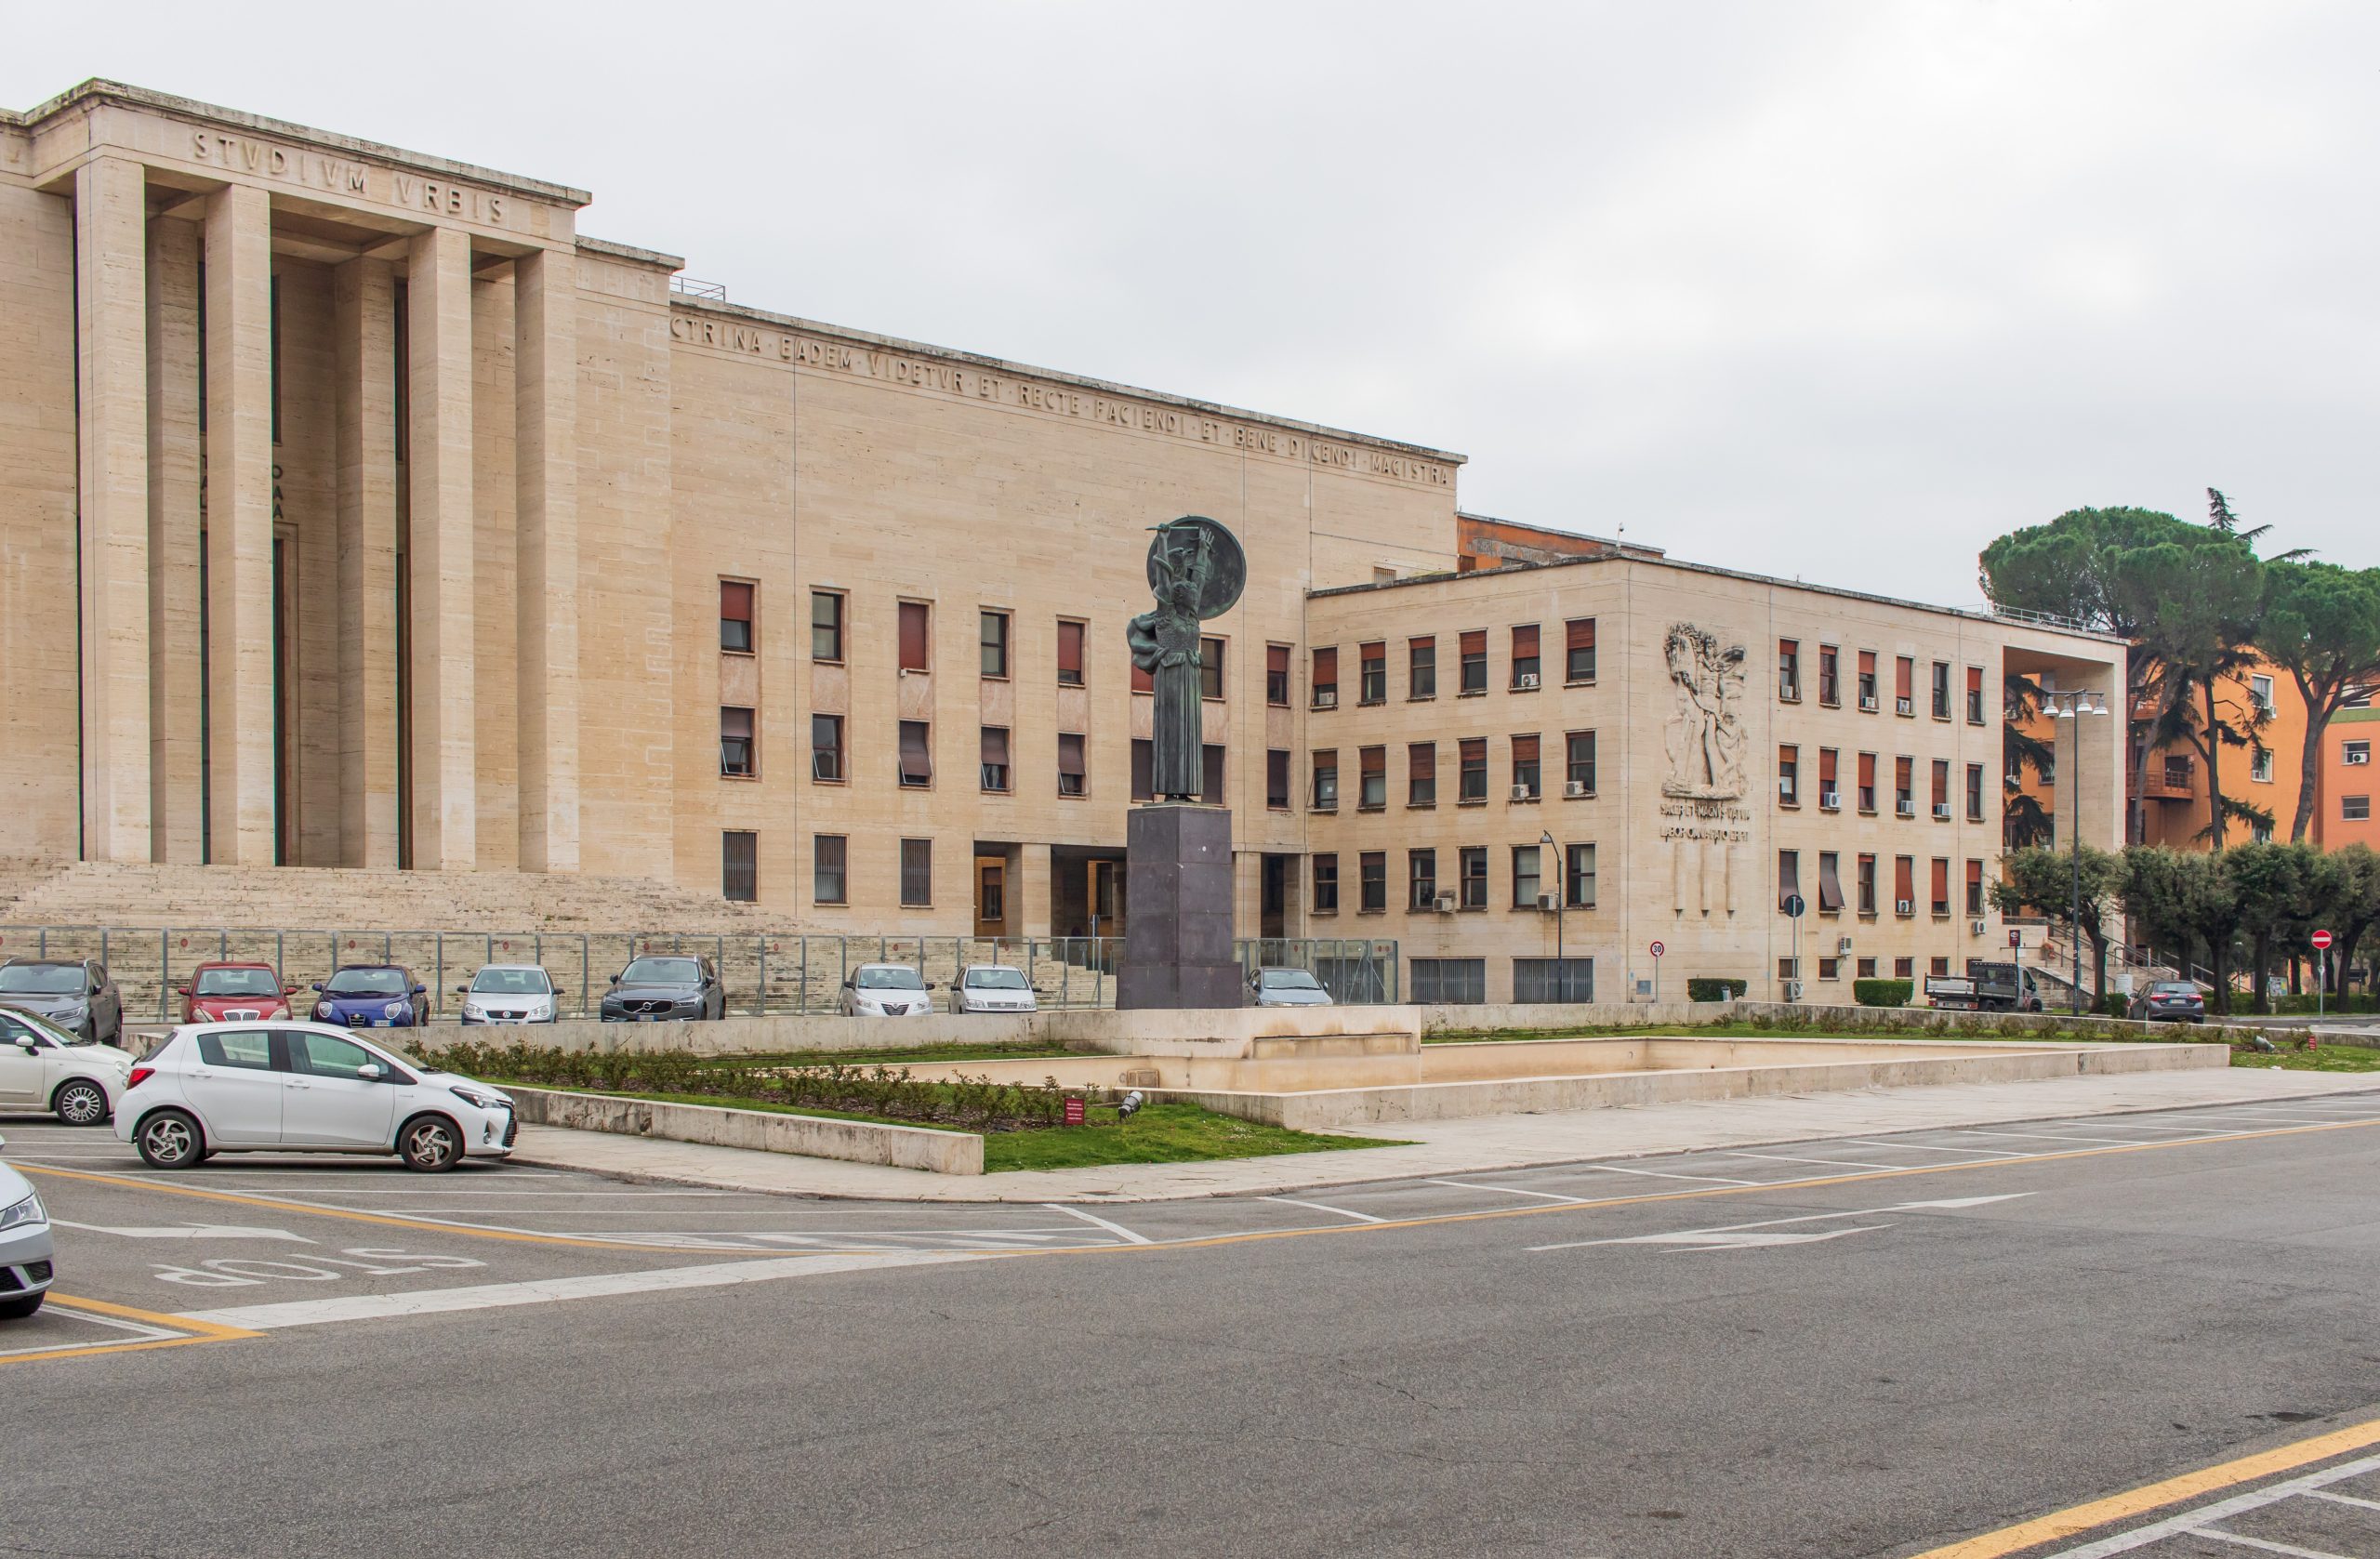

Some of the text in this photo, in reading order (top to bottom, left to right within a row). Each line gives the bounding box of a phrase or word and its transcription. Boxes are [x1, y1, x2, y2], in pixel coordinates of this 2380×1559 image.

[193, 131, 502, 224] STVDIVM VRBIS
[780, 335, 853, 370] EADEM
[868, 352, 964, 392] VIDETVR
[979, 376, 1002, 399] ET
[1019, 384, 1079, 415] RECTE
[1095, 399, 1184, 435] FACIENDI
[1201, 420, 1222, 443] ET
[1235, 427, 1276, 453] BENE
[1289, 437, 1357, 469] DICENDI
[1370, 454, 1448, 484] MAGISTRA
[1653, 945, 1662, 953] 30
[149, 1247, 489, 1288] STOP
